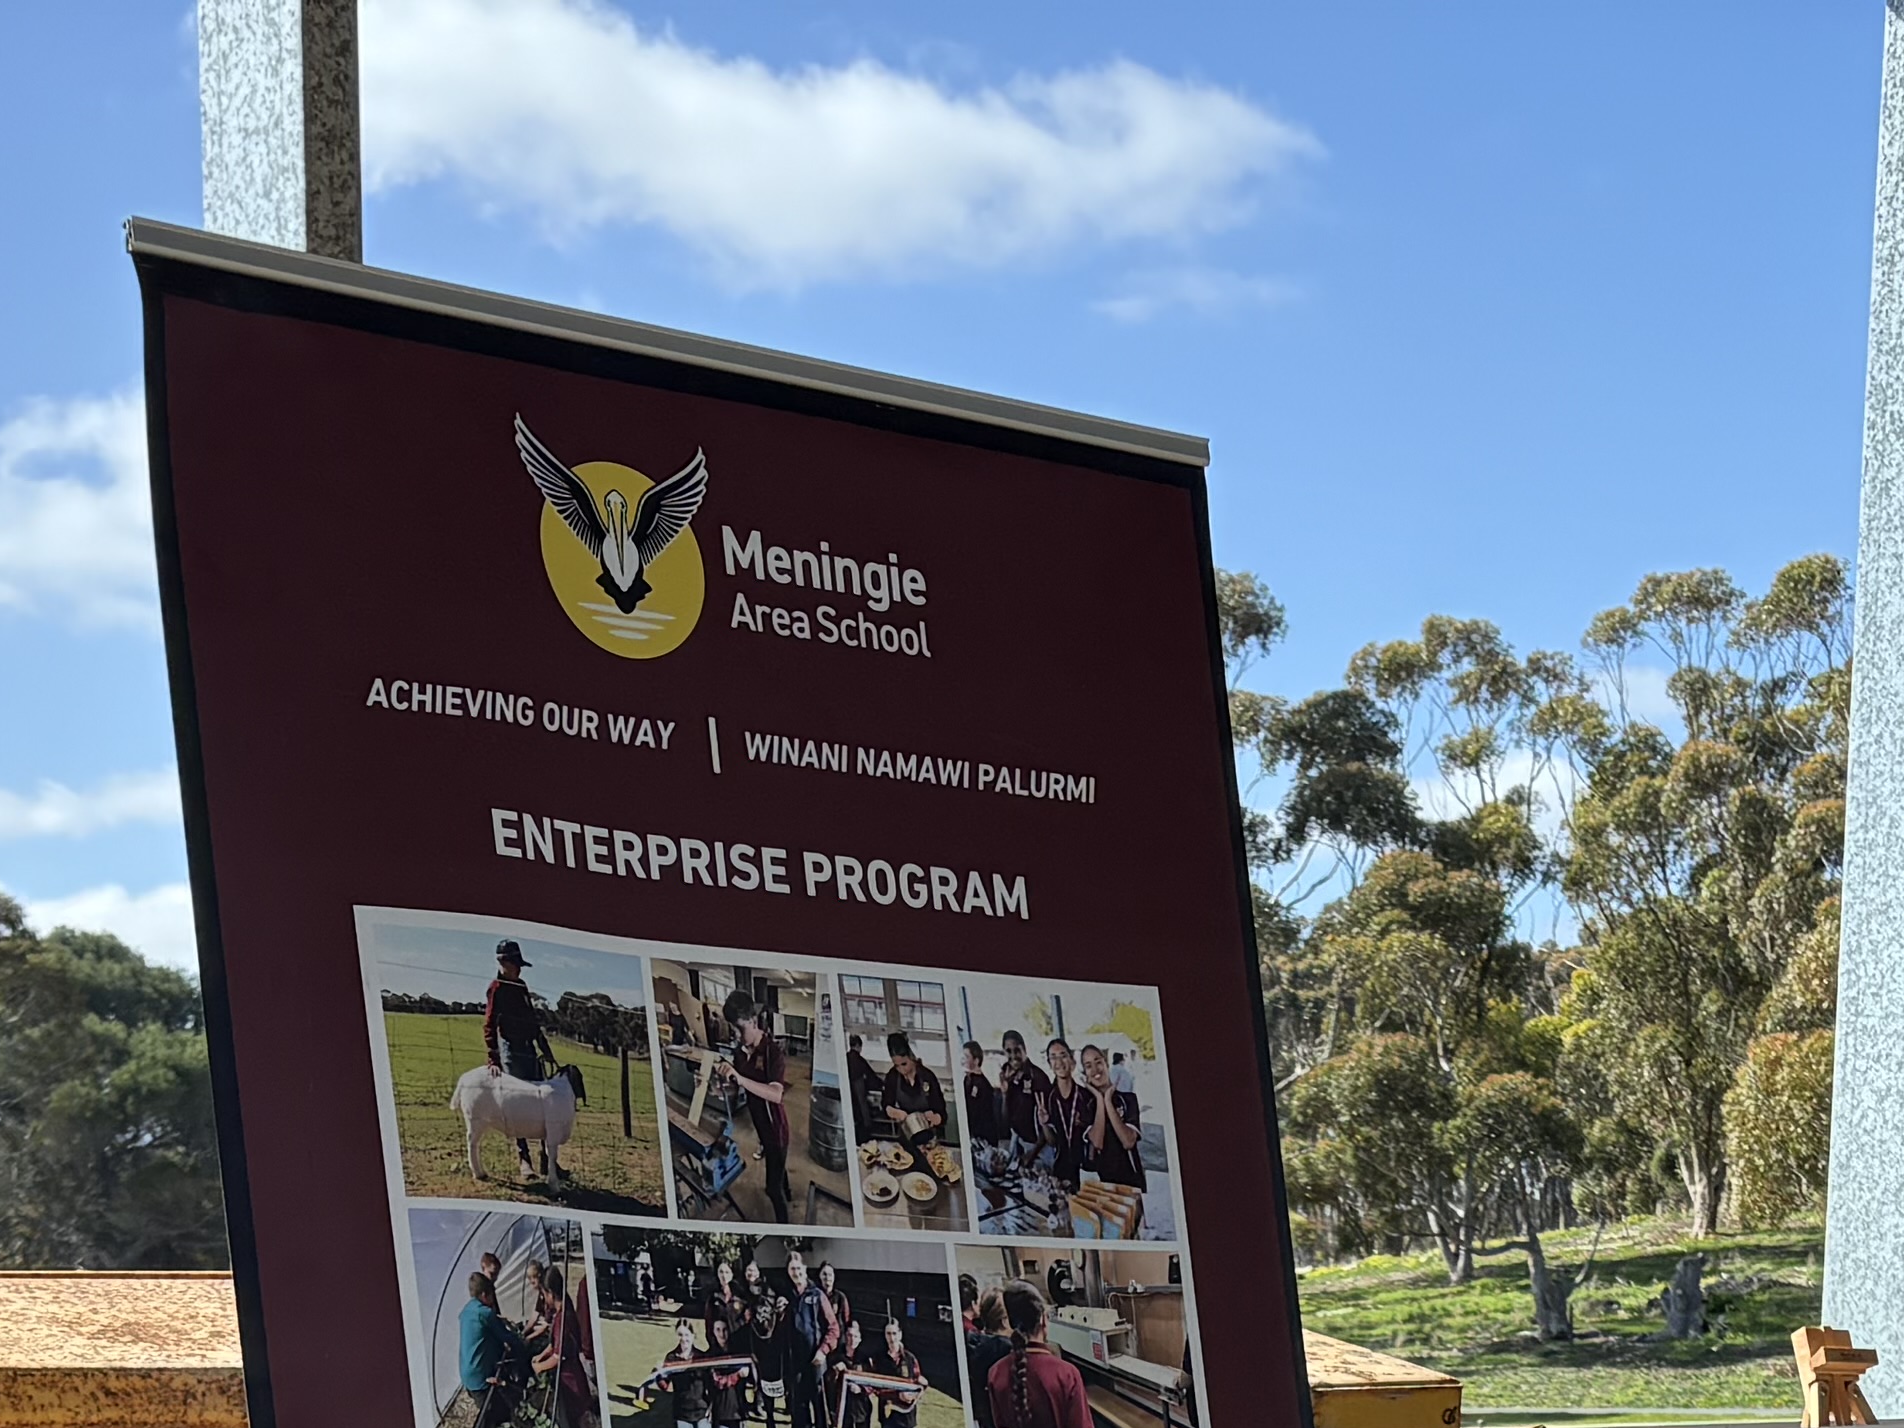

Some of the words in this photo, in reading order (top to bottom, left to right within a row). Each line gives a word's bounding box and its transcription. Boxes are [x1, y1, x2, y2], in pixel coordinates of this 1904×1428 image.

[721, 524, 927, 612] Meningie
[730, 592, 812, 640] Area
[816, 605, 932, 658] School
[365, 677, 535, 727] ACHIEVING
[542, 701, 599, 741] OUR
[607, 713, 676, 750] WAY
[744, 730, 848, 773] WINANI
[856, 746, 970, 789] NAMAWI
[977, 763, 1096, 804] PALURMI
[490, 807, 791, 894] ENTERPRISE
[802, 851, 1030, 920] PROGRAM
